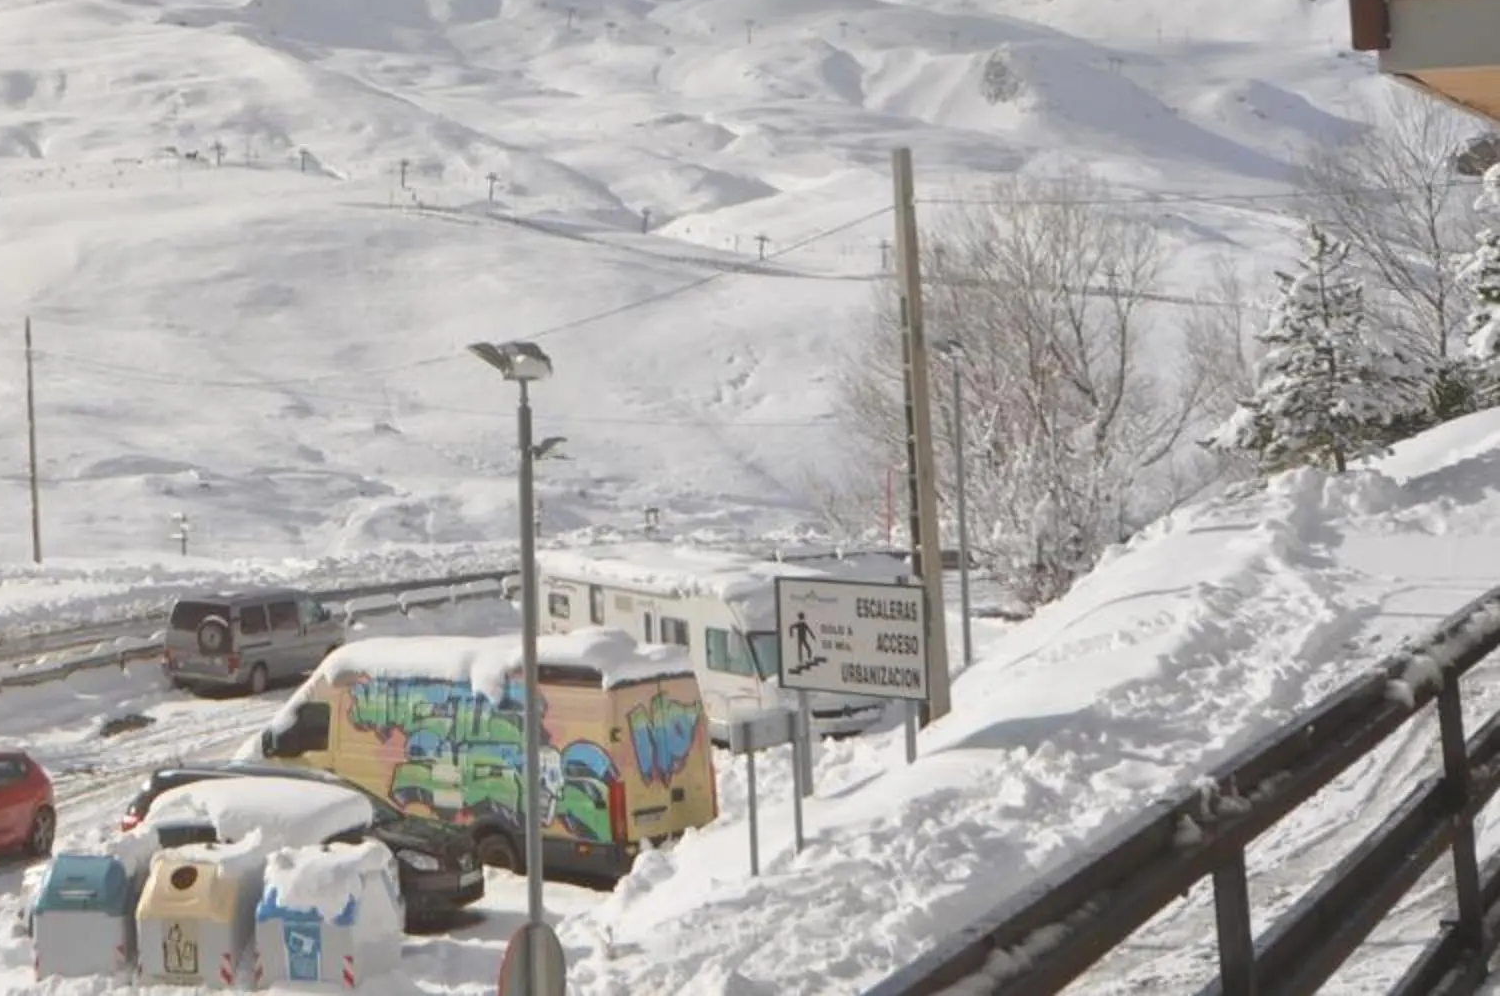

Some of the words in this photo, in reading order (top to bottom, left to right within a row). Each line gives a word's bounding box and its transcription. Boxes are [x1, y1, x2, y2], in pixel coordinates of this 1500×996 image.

[856, 596, 917, 621] ESCALERAS
[876, 632, 918, 655] ACCESO
[841, 662, 921, 689] URBANIZACION
